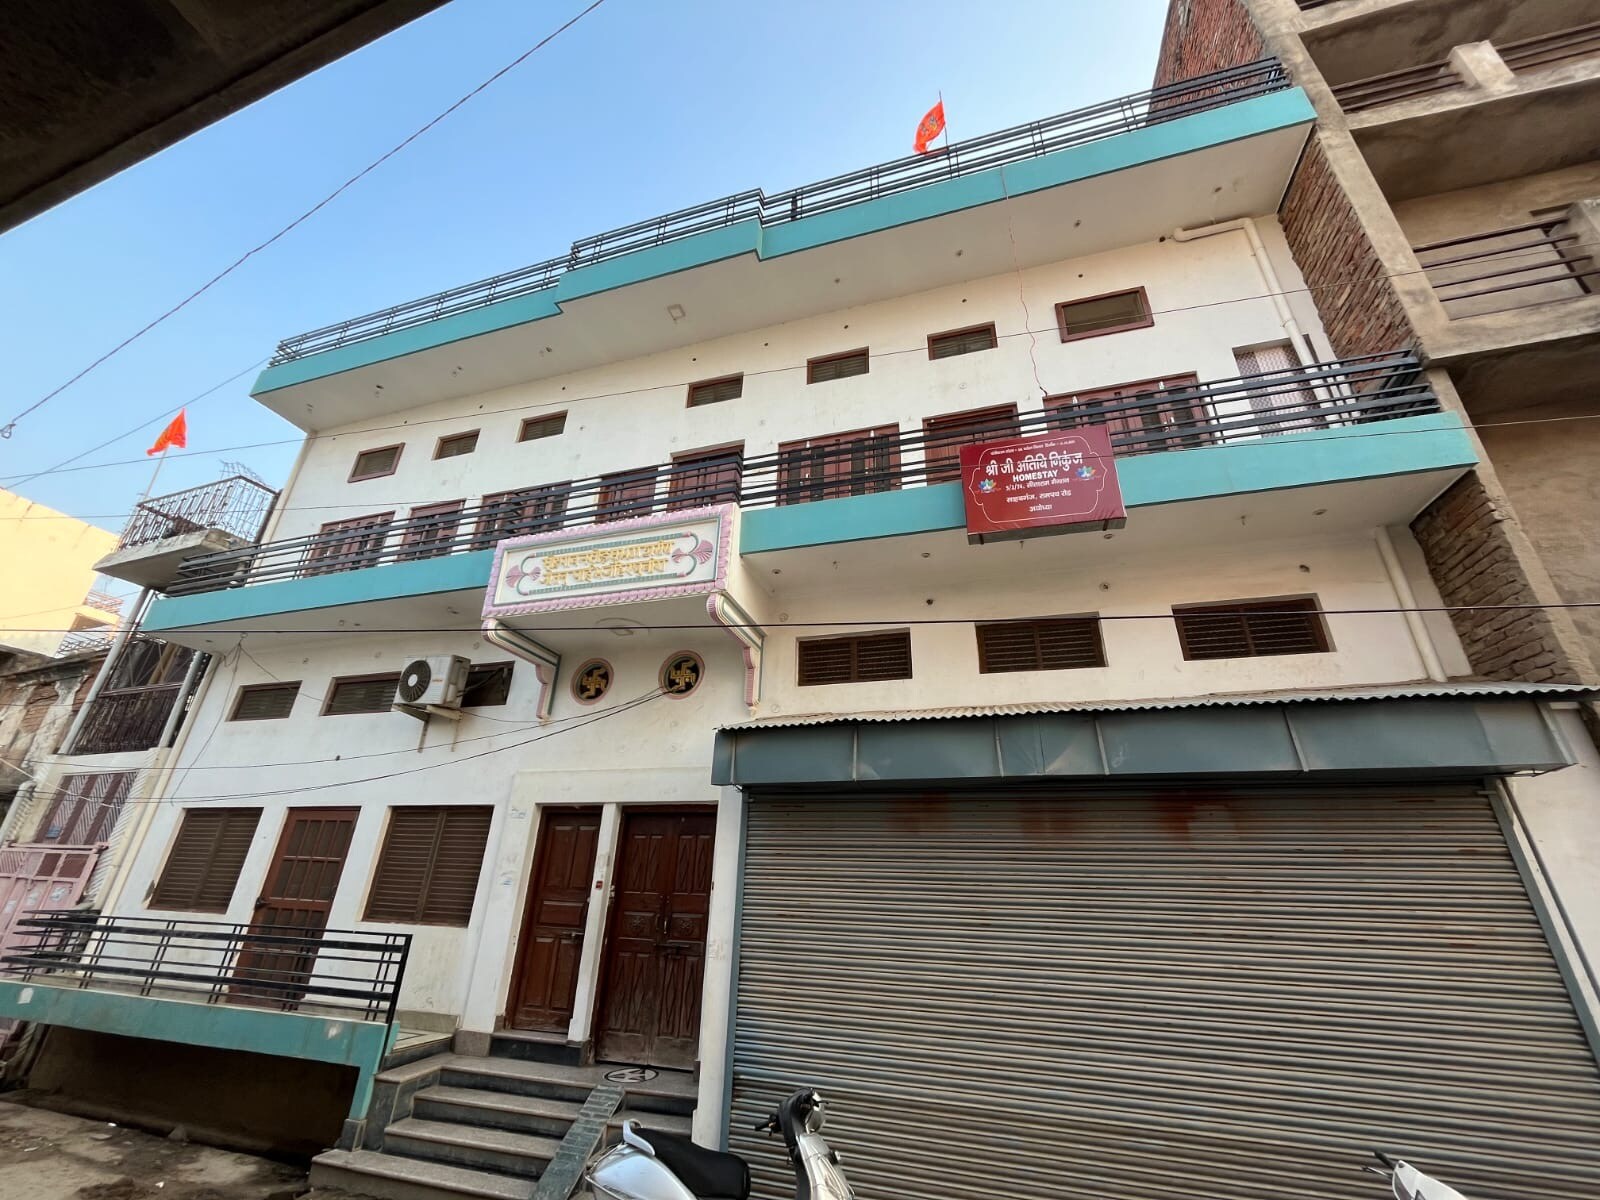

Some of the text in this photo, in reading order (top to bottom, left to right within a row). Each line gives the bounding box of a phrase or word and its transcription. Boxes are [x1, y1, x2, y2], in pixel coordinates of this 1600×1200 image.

[986, 459, 999, 476] श्री
[1000, 457, 1014, 474] जी
[1012, 470, 1058, 482] HOMESTAY
